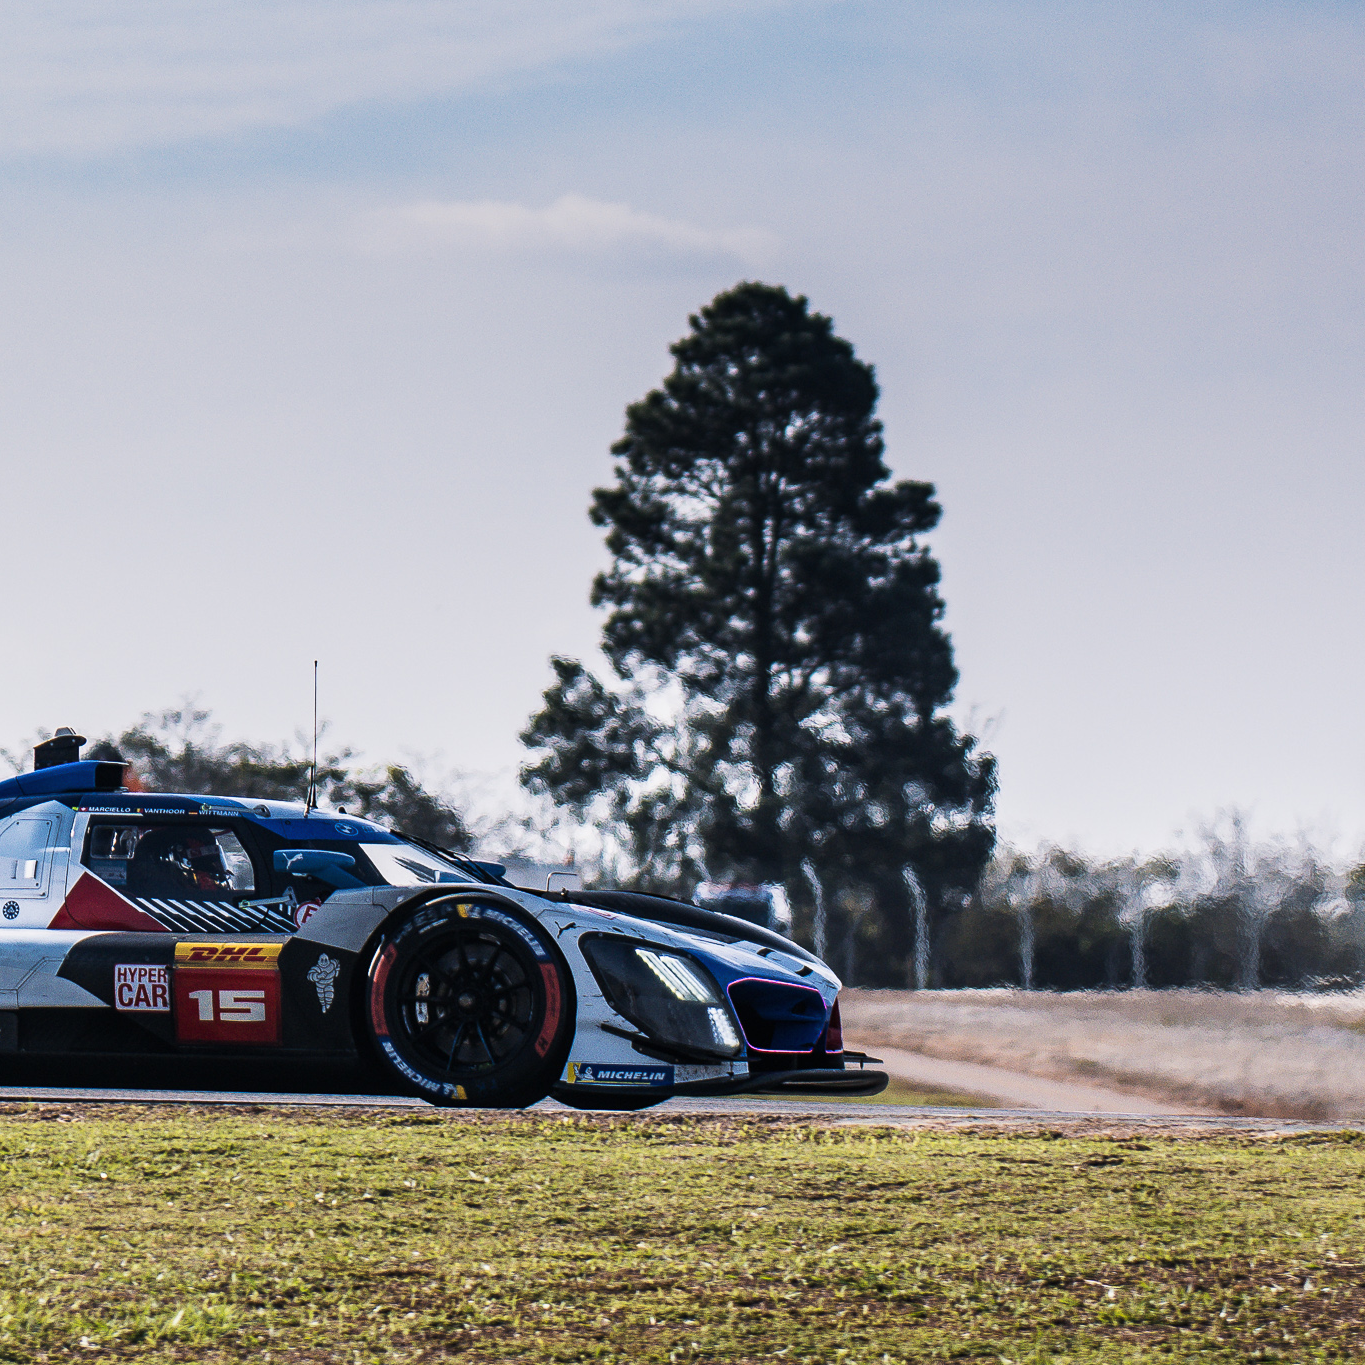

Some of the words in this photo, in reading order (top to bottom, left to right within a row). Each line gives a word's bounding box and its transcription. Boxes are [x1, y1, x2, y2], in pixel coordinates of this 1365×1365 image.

[144, 807, 185, 815] VANTHOOR
[198, 809, 239, 817] WITTMANN
[188, 947, 267, 961] DHL
[117, 967, 167, 983] HYPER
[118, 983, 168, 1007] CAR
[189, 990, 265, 1021] 15
[597, 1070, 666, 1080] MICHELIN
